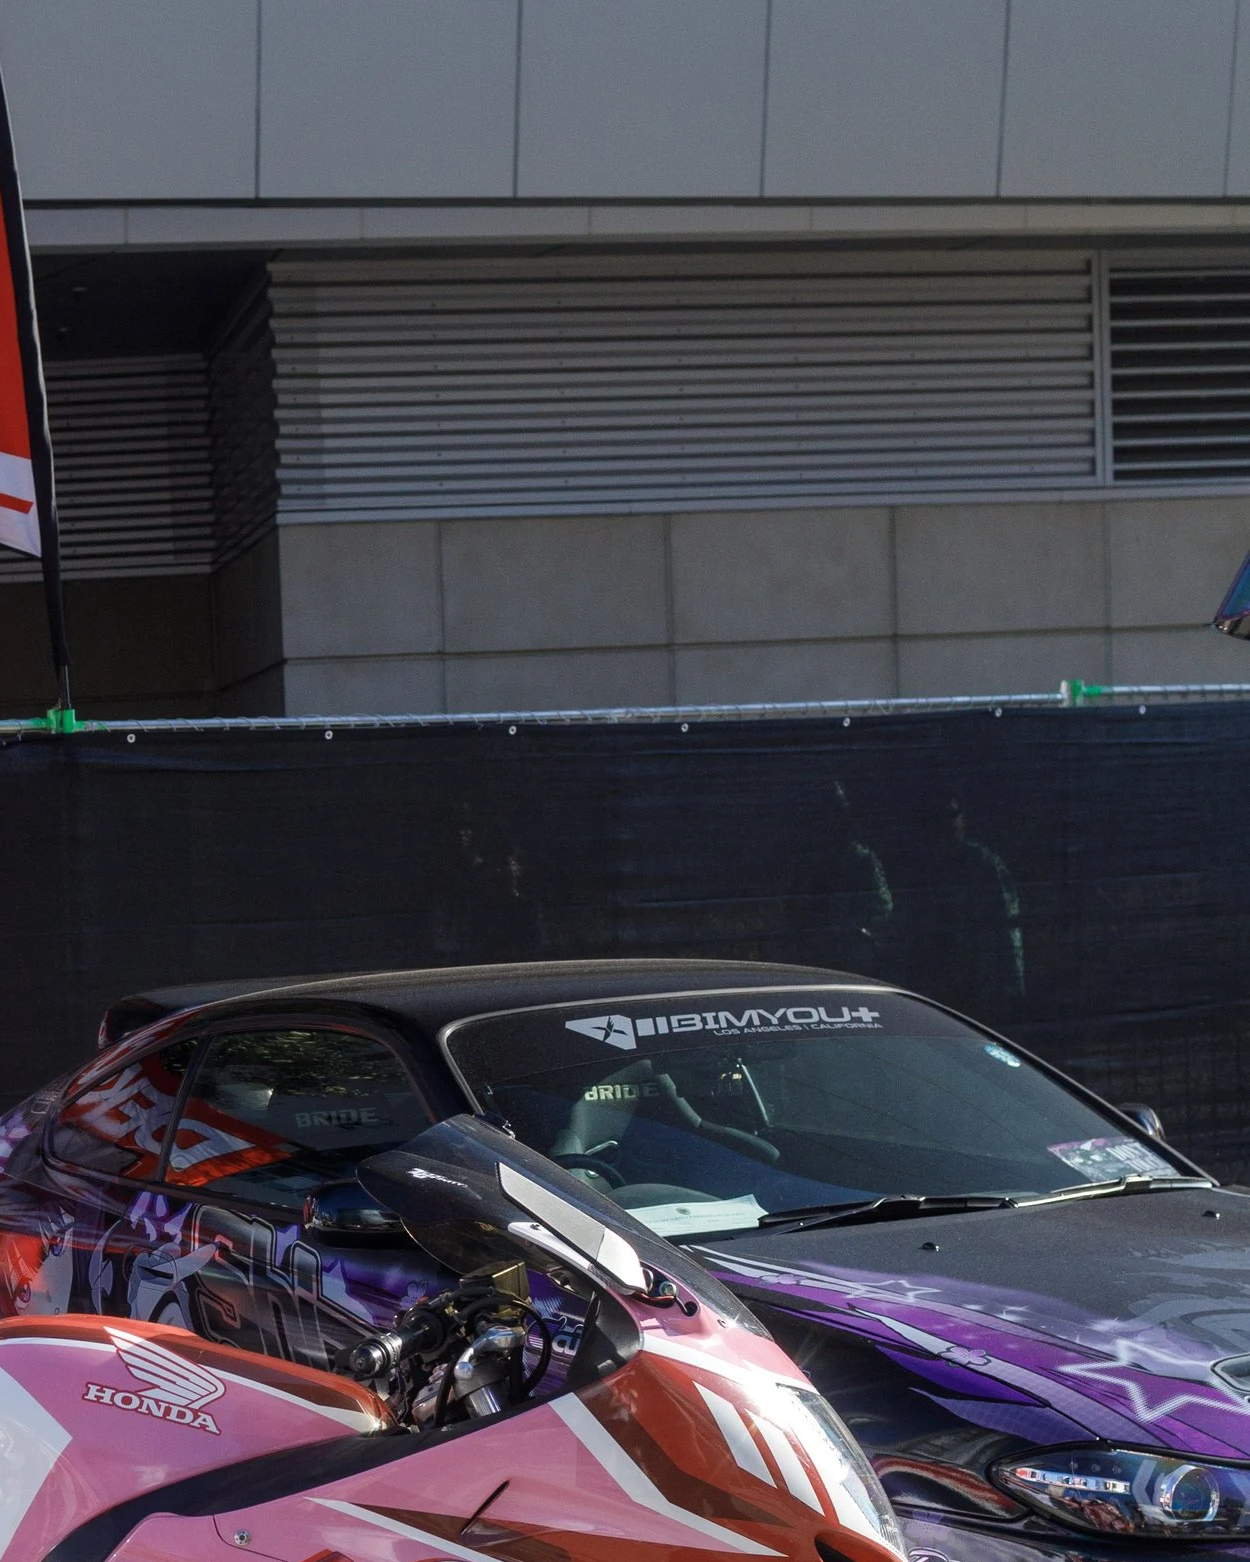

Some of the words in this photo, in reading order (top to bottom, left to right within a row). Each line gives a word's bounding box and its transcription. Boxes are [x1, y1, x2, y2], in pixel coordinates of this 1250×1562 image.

[714, 1028, 740, 1036] LOS
[743, 1025, 802, 1035] ANGELES
[812, 1022, 883, 1031] CALIFORNIA
[293, 1107, 379, 1128] BRIDE
[83, 1383, 221, 1435] HONDA
